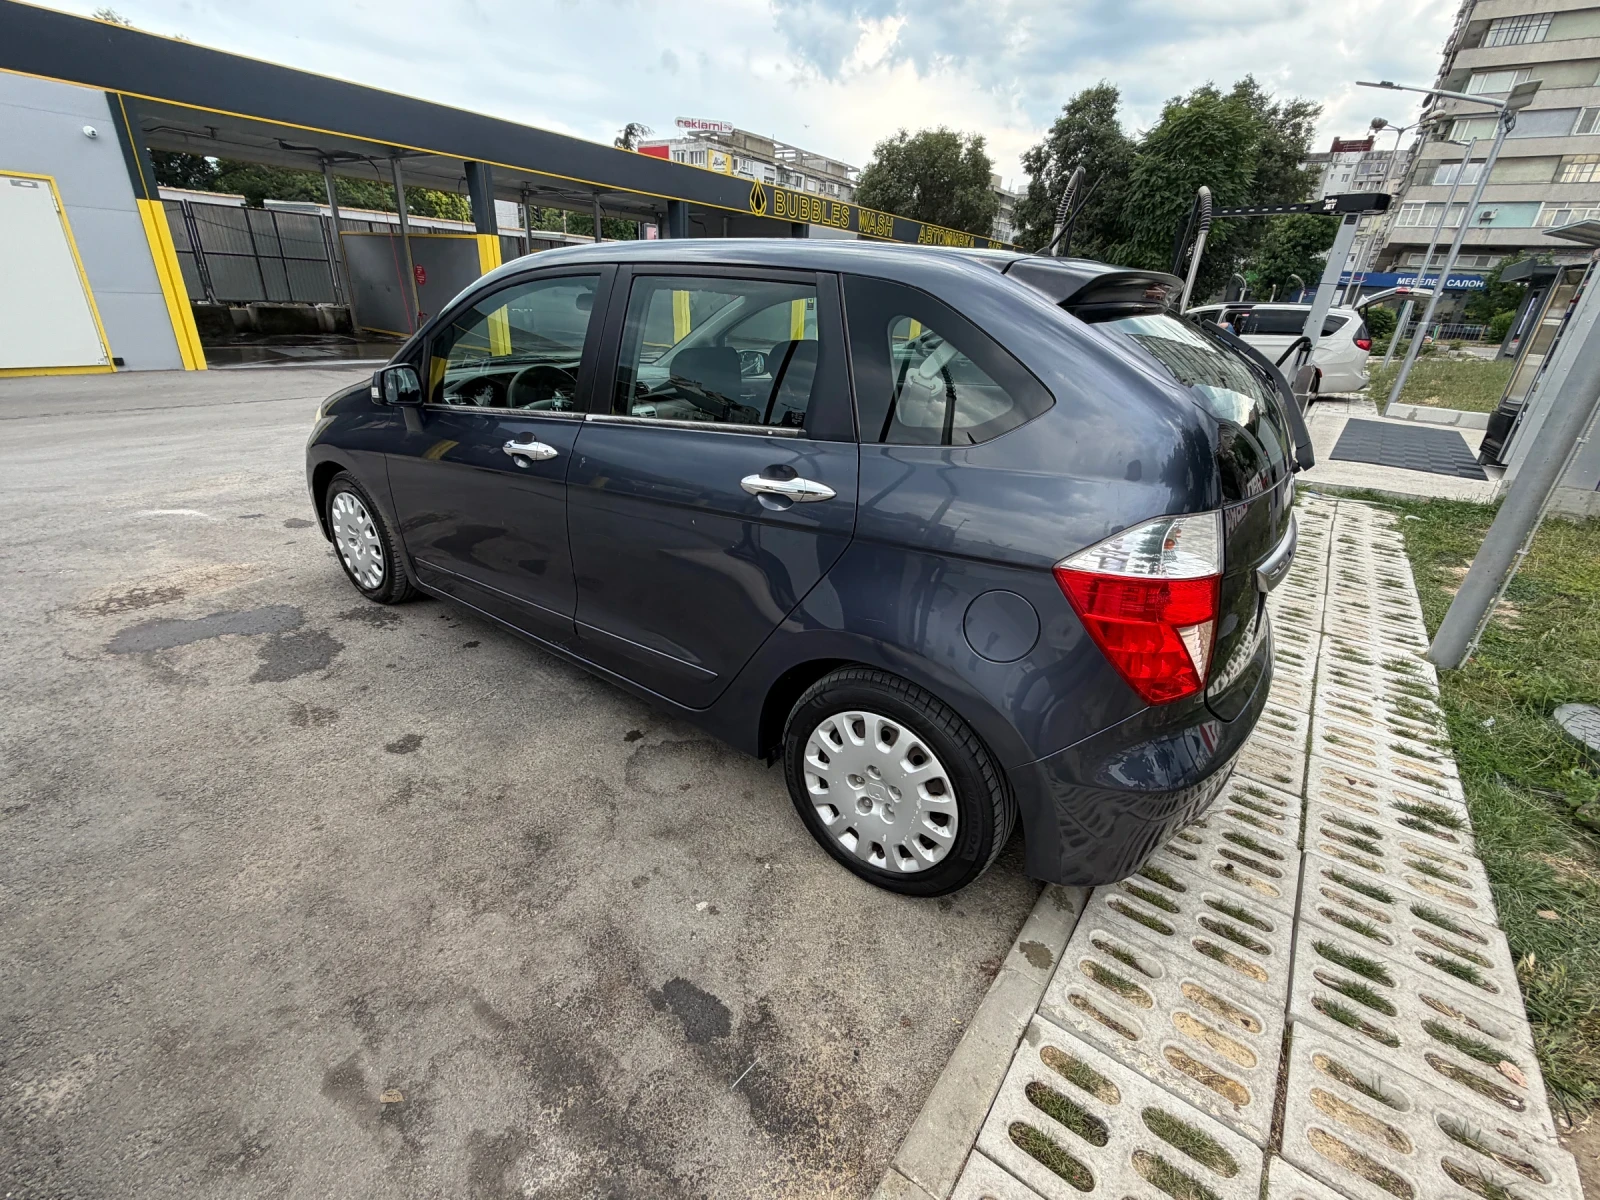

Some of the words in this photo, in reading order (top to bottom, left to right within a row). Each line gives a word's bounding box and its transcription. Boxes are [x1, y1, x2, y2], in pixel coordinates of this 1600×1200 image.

[774, 190, 850, 228] BUBBLES
[858, 209, 893, 237] WASH
[1396, 277, 1440, 286] МЕБЕЛЕ
[1447, 279, 1485, 288] САЛОН
